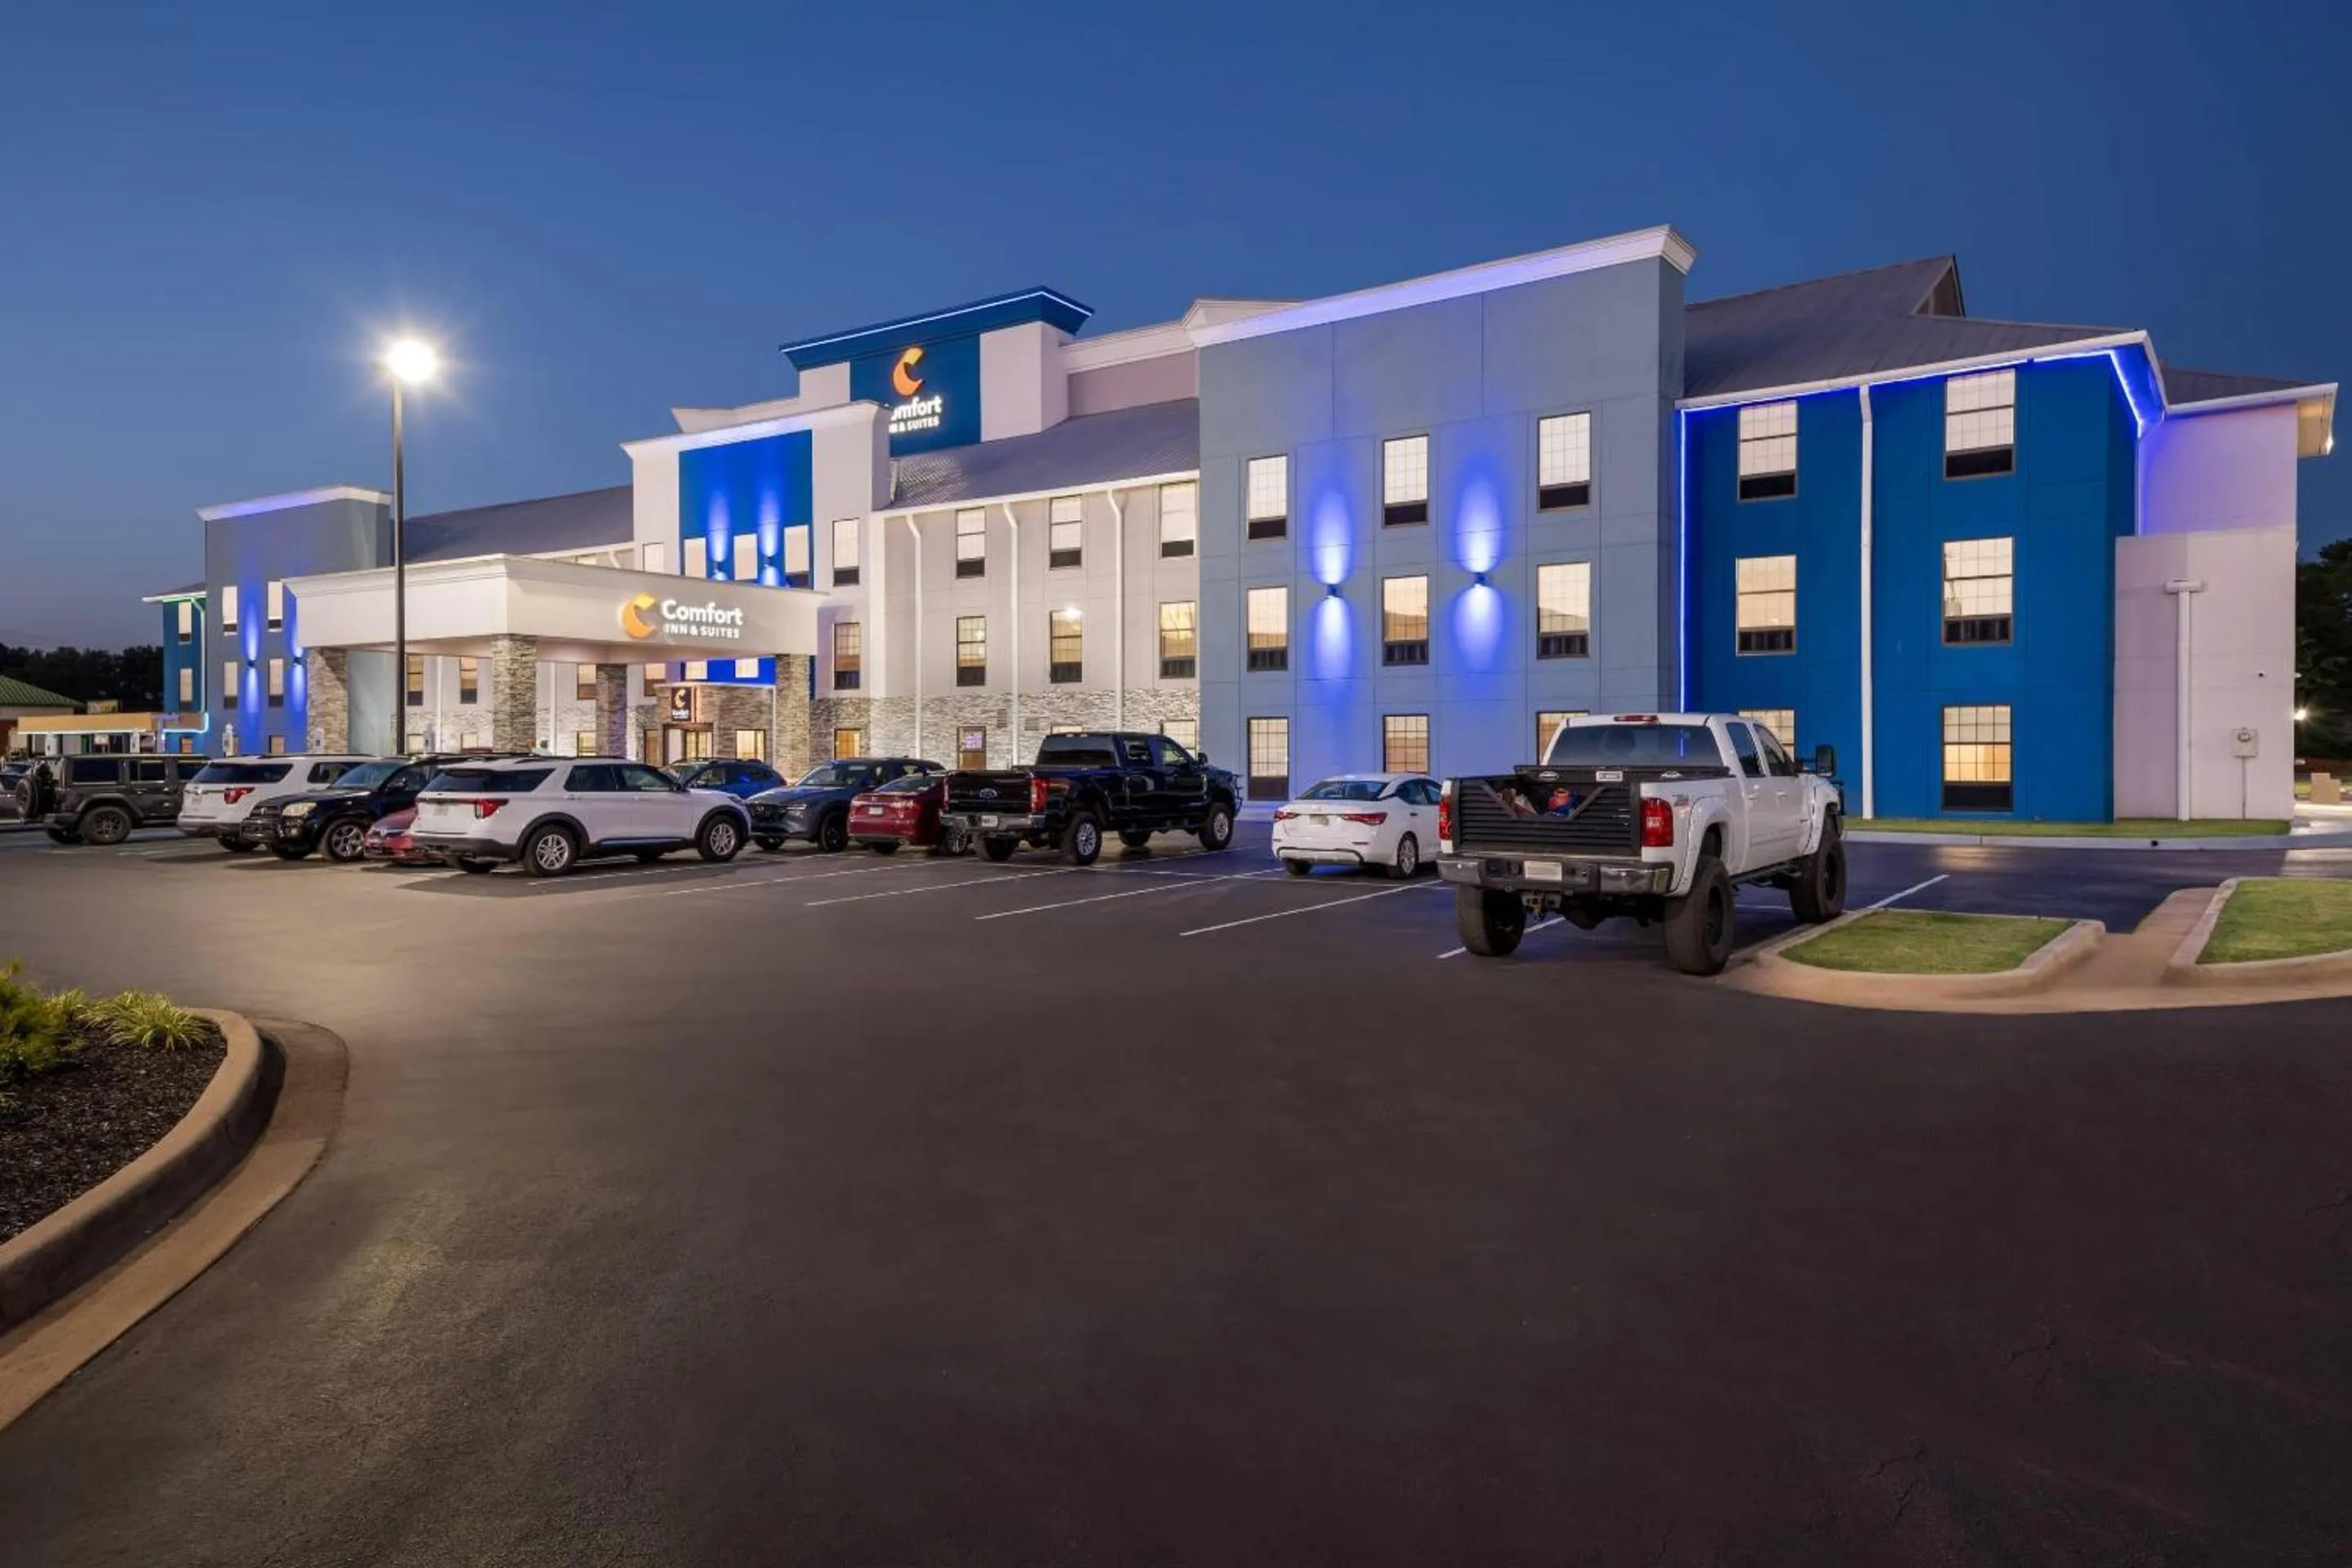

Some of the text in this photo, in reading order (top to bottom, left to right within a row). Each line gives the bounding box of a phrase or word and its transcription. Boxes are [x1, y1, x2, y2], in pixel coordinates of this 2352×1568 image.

[891, 395, 942, 421] mfort
[906, 416, 940, 430] SUITES
[661, 599, 743, 626] Comfort
[664, 623, 740, 639] INN & SUITES
